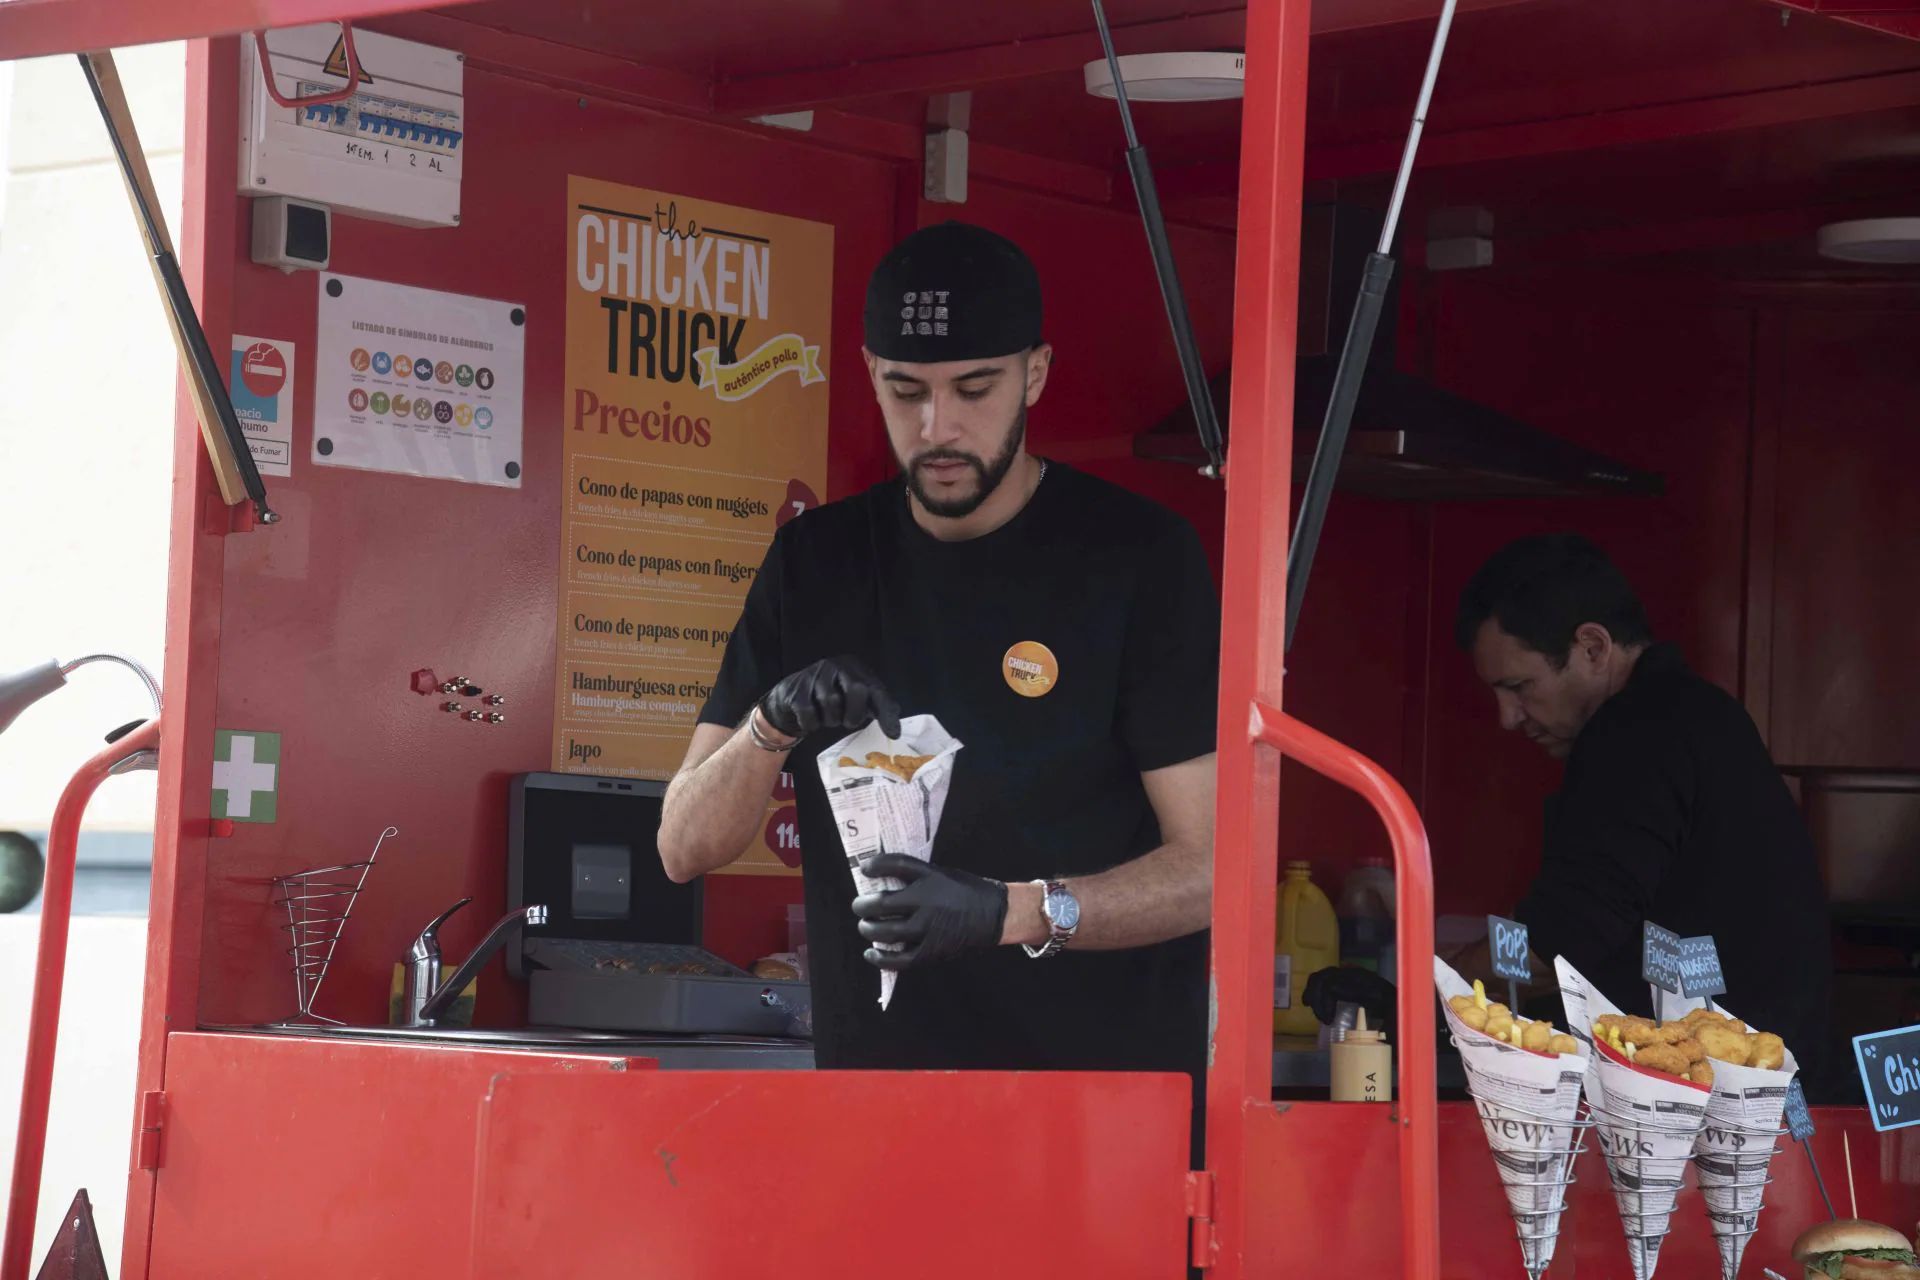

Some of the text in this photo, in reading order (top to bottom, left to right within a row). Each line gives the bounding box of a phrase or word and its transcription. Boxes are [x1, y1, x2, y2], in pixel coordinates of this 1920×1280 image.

[409, 153, 416, 167] 2
[654, 201, 702, 241] the
[577, 214, 770, 320] CHICKEN
[901, 306, 949, 320] OUR
[352, 320, 384, 334] LISTADO
[386, 326, 396, 336] DE
[439, 335, 449, 344] DE
[600, 296, 746, 386] TRUCK
[901, 321, 948, 336] AGE
[724, 349, 798, 393] auténtico pollo
[235, 408, 262, 419] pacio
[240, 420, 268, 432] humo
[573, 387, 712, 448] Precios
[260, 446, 282, 456] Fumar
[578, 476, 768, 518] Cono de papas con nuggets
[576, 544, 615, 564] Cono
[618, 549, 636, 567] de
[639, 555, 682, 575] papas
[685, 560, 710, 575] con
[574, 613, 733, 648] Cono de papas con po
[572, 672, 675, 699] Hamburguesa
[572, 692, 696, 716] Hamburguesa completa
[568, 738, 602, 763] Japo
[1496, 922, 1528, 969] POPS
[1646, 939, 1680, 974] FINGERS
[1679, 954, 1719, 979] NUGGETS
[1365, 1072, 1377, 1102] ESA
[1610, 1131, 1654, 1157] ws
[1704, 1125, 1746, 1148] ws
